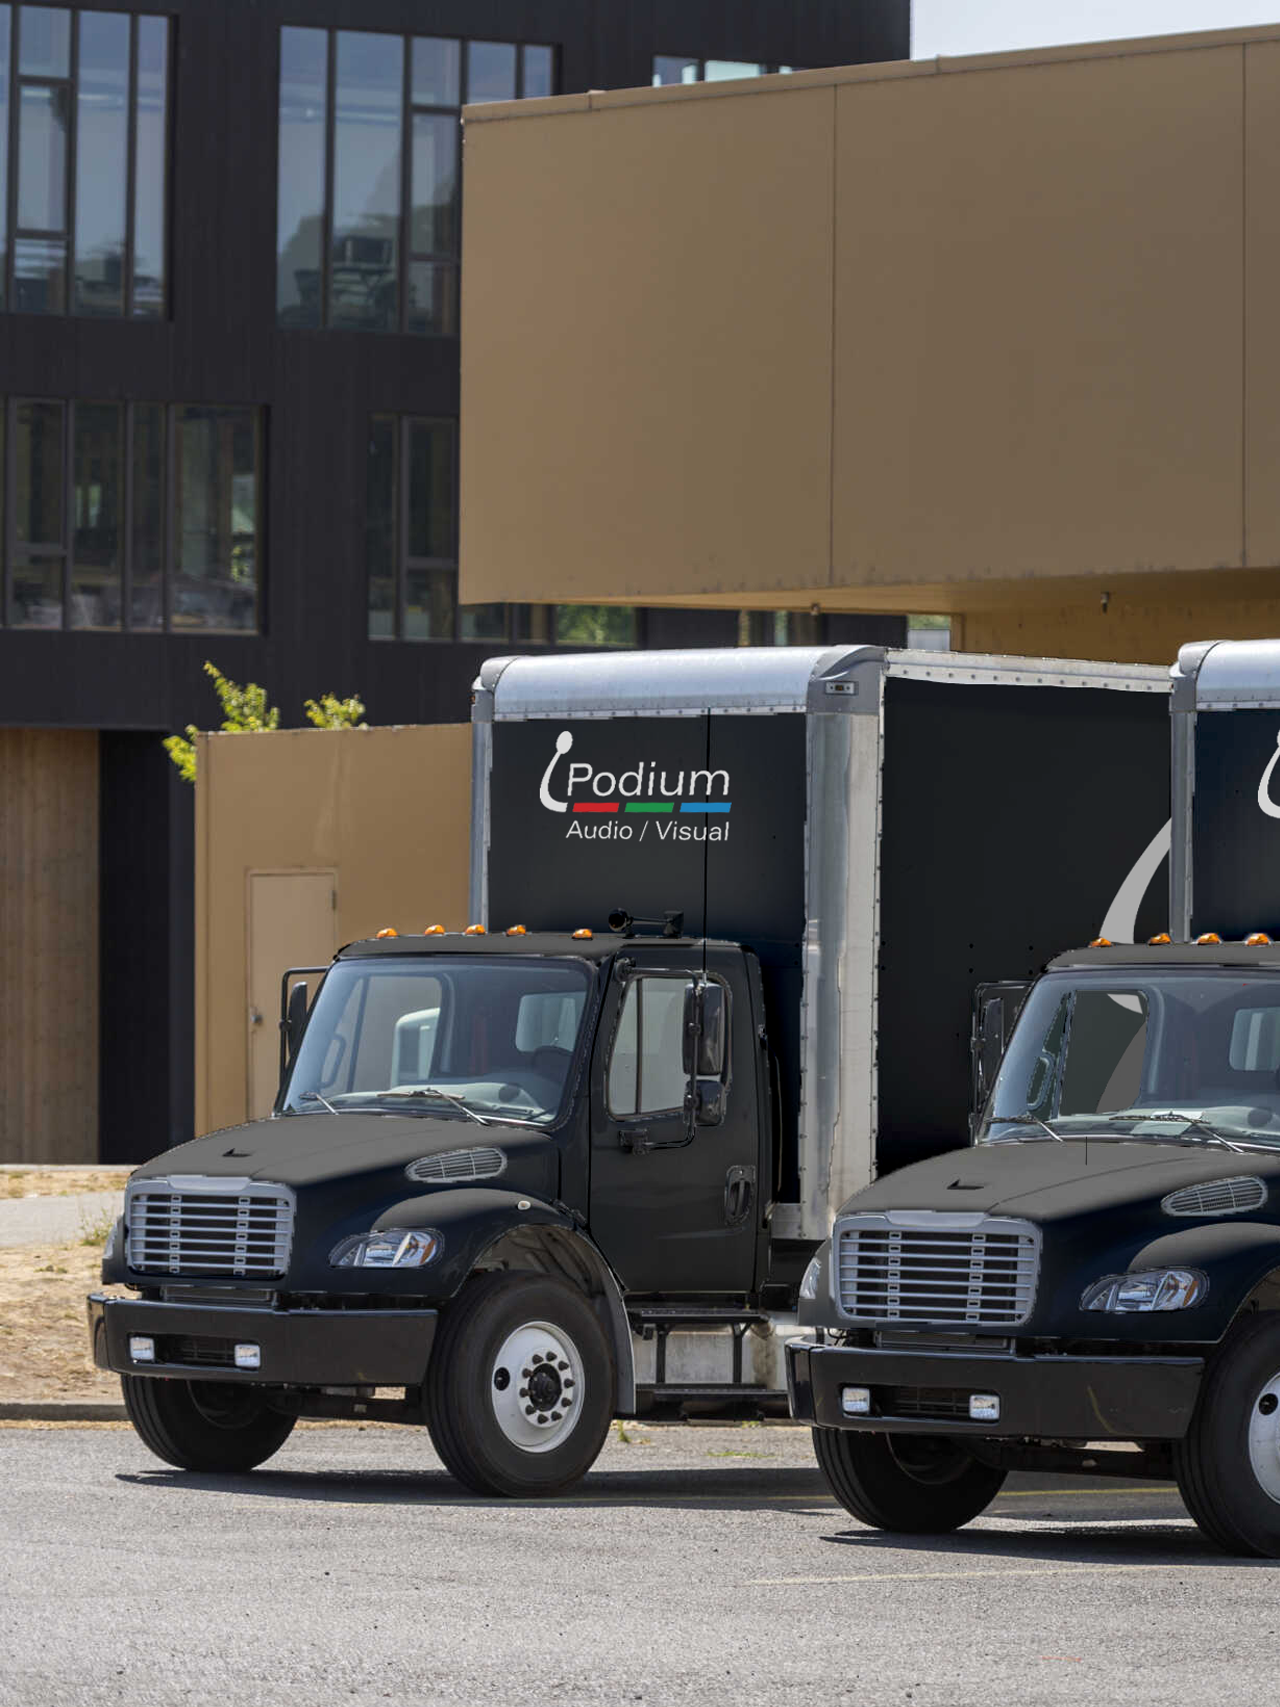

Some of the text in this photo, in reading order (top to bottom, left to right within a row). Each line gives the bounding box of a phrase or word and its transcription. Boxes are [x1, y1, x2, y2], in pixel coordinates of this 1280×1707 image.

[567, 761, 730, 797] Podium
[566, 820, 730, 842] Audio / Visual
